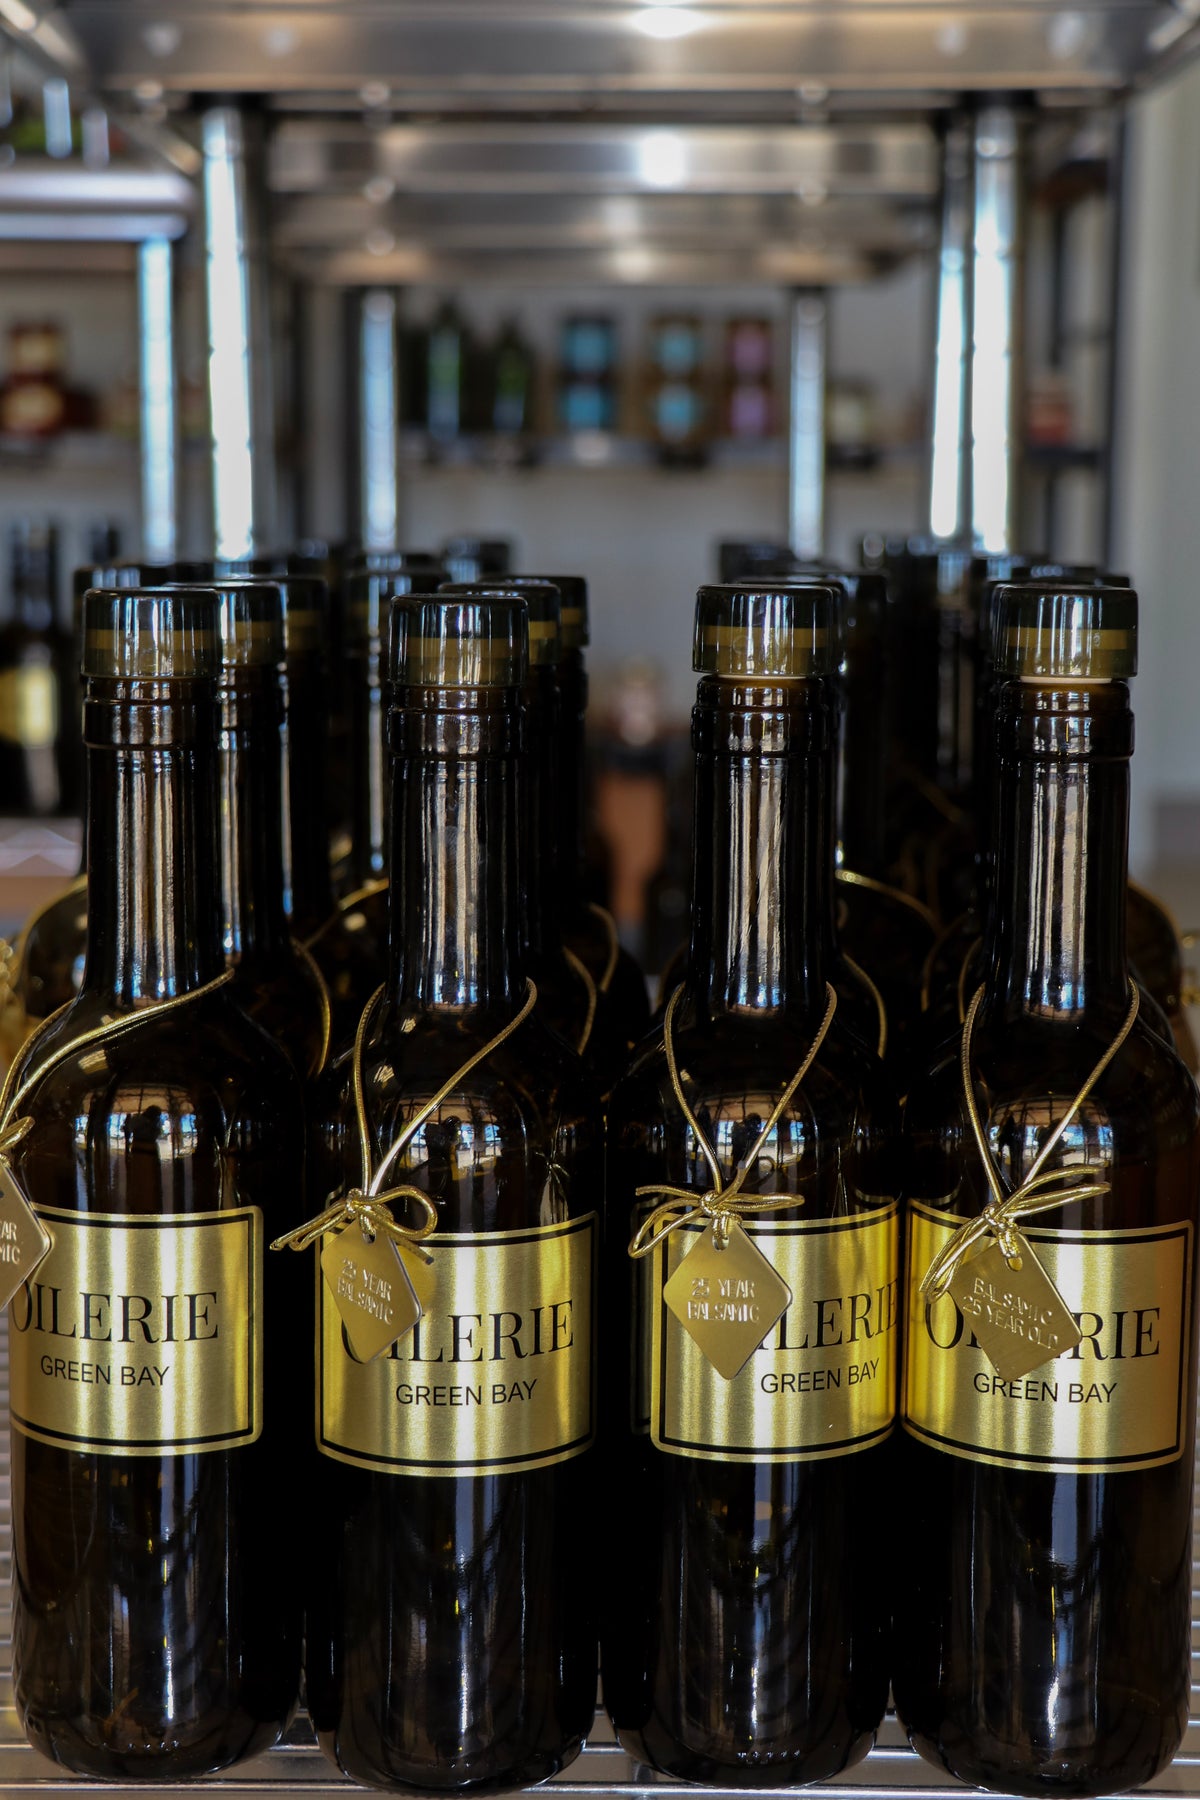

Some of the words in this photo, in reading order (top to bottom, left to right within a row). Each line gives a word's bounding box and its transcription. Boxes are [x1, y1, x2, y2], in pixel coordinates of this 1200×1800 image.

[337, 1277, 393, 1325] BALSAMIC
[363, 1269, 392, 1302] YEAR
[692, 1278, 710, 1298] 25
[717, 1278, 755, 1298] YEAR
[973, 1277, 1053, 1326] BALSAMIC
[687, 1301, 760, 1323] BALSAMIC
[924, 1288, 1161, 1361] ORIE
[963, 1295, 982, 1316] 25
[986, 1305, 1024, 1337] YEAR
[1028, 1326, 1059, 1351] OLD
[341, 1299, 574, 1365] LERIE
[40, 1355, 111, 1385] GREEN
[121, 1366, 170, 1386] BAY
[760, 1369, 841, 1394] GREEN
[848, 1358, 880, 1385] BAY
[972, 1372, 1058, 1402] GREEN
[1068, 1382, 1117, 1403] BAY
[396, 1383, 482, 1406] GREEN
[491, 1379, 538, 1404] BAY
